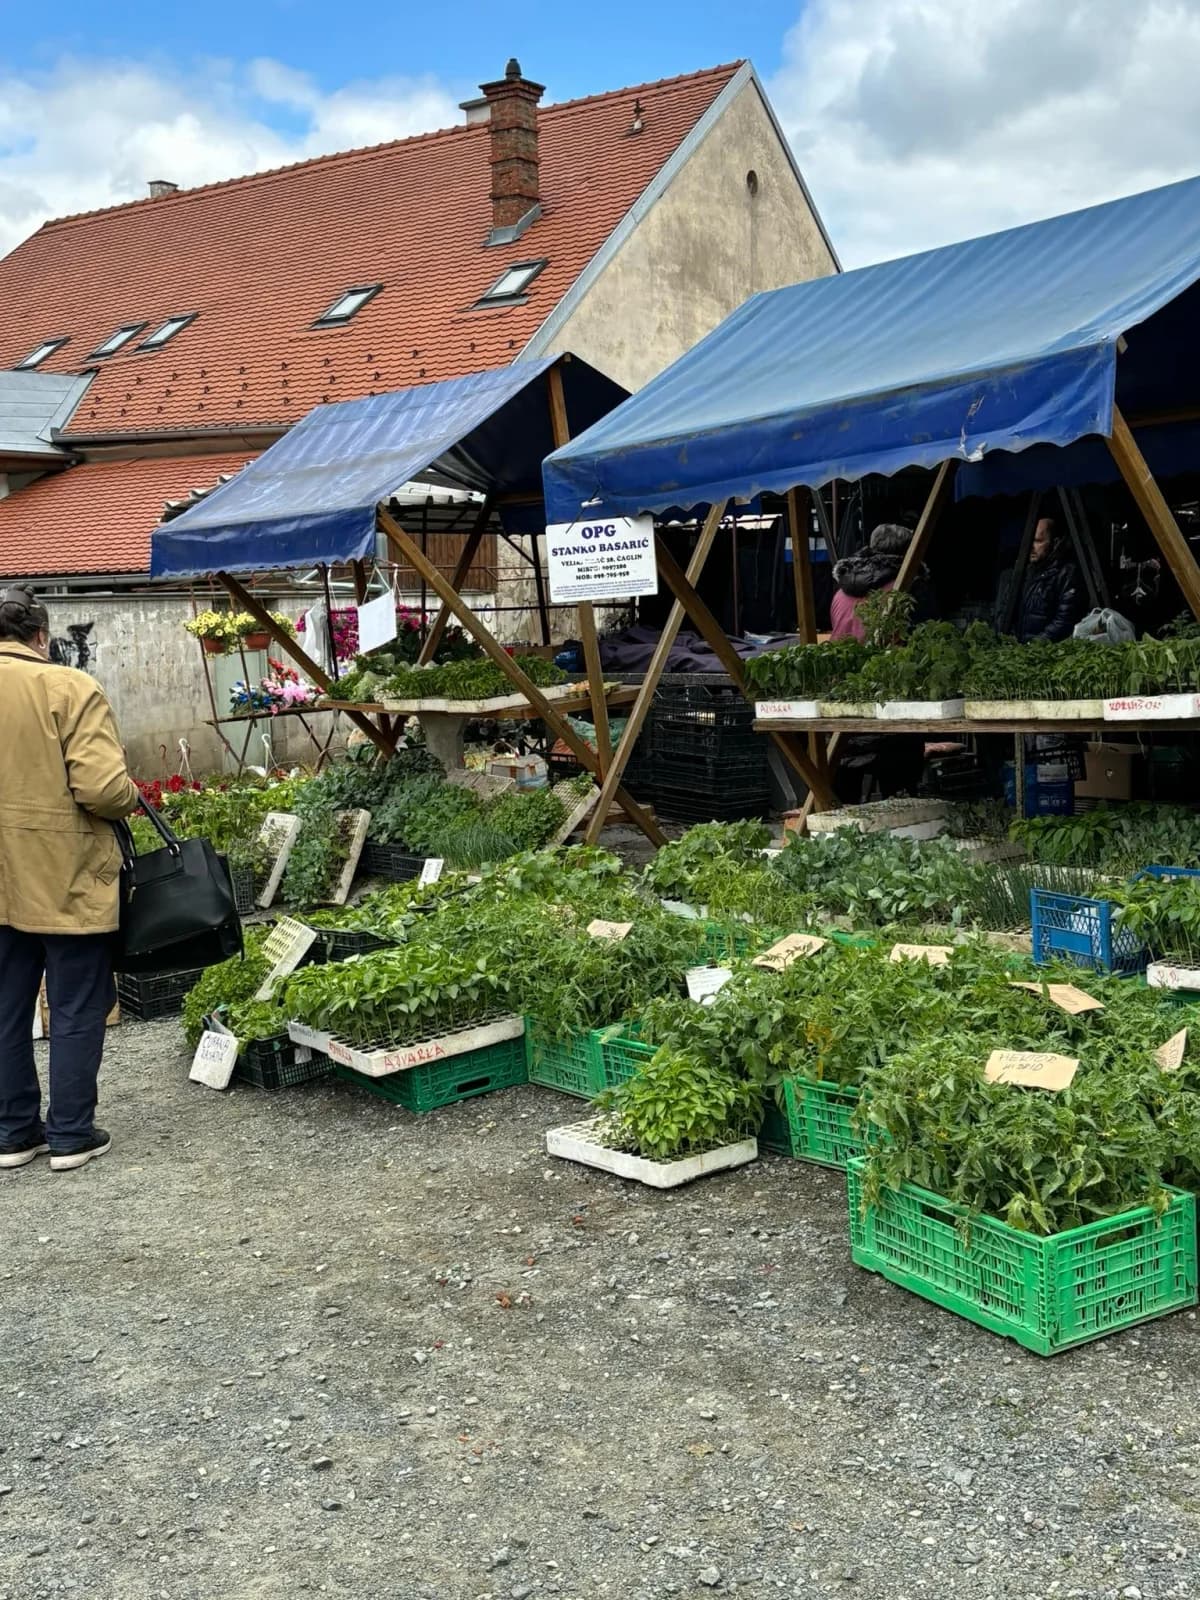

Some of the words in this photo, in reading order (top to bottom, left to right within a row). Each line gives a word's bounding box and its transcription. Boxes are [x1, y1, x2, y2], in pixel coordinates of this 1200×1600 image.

[581, 524, 617, 539] OPG
[552, 545, 596, 556] STANKO
[599, 537, 649, 552] BASARIĆ
